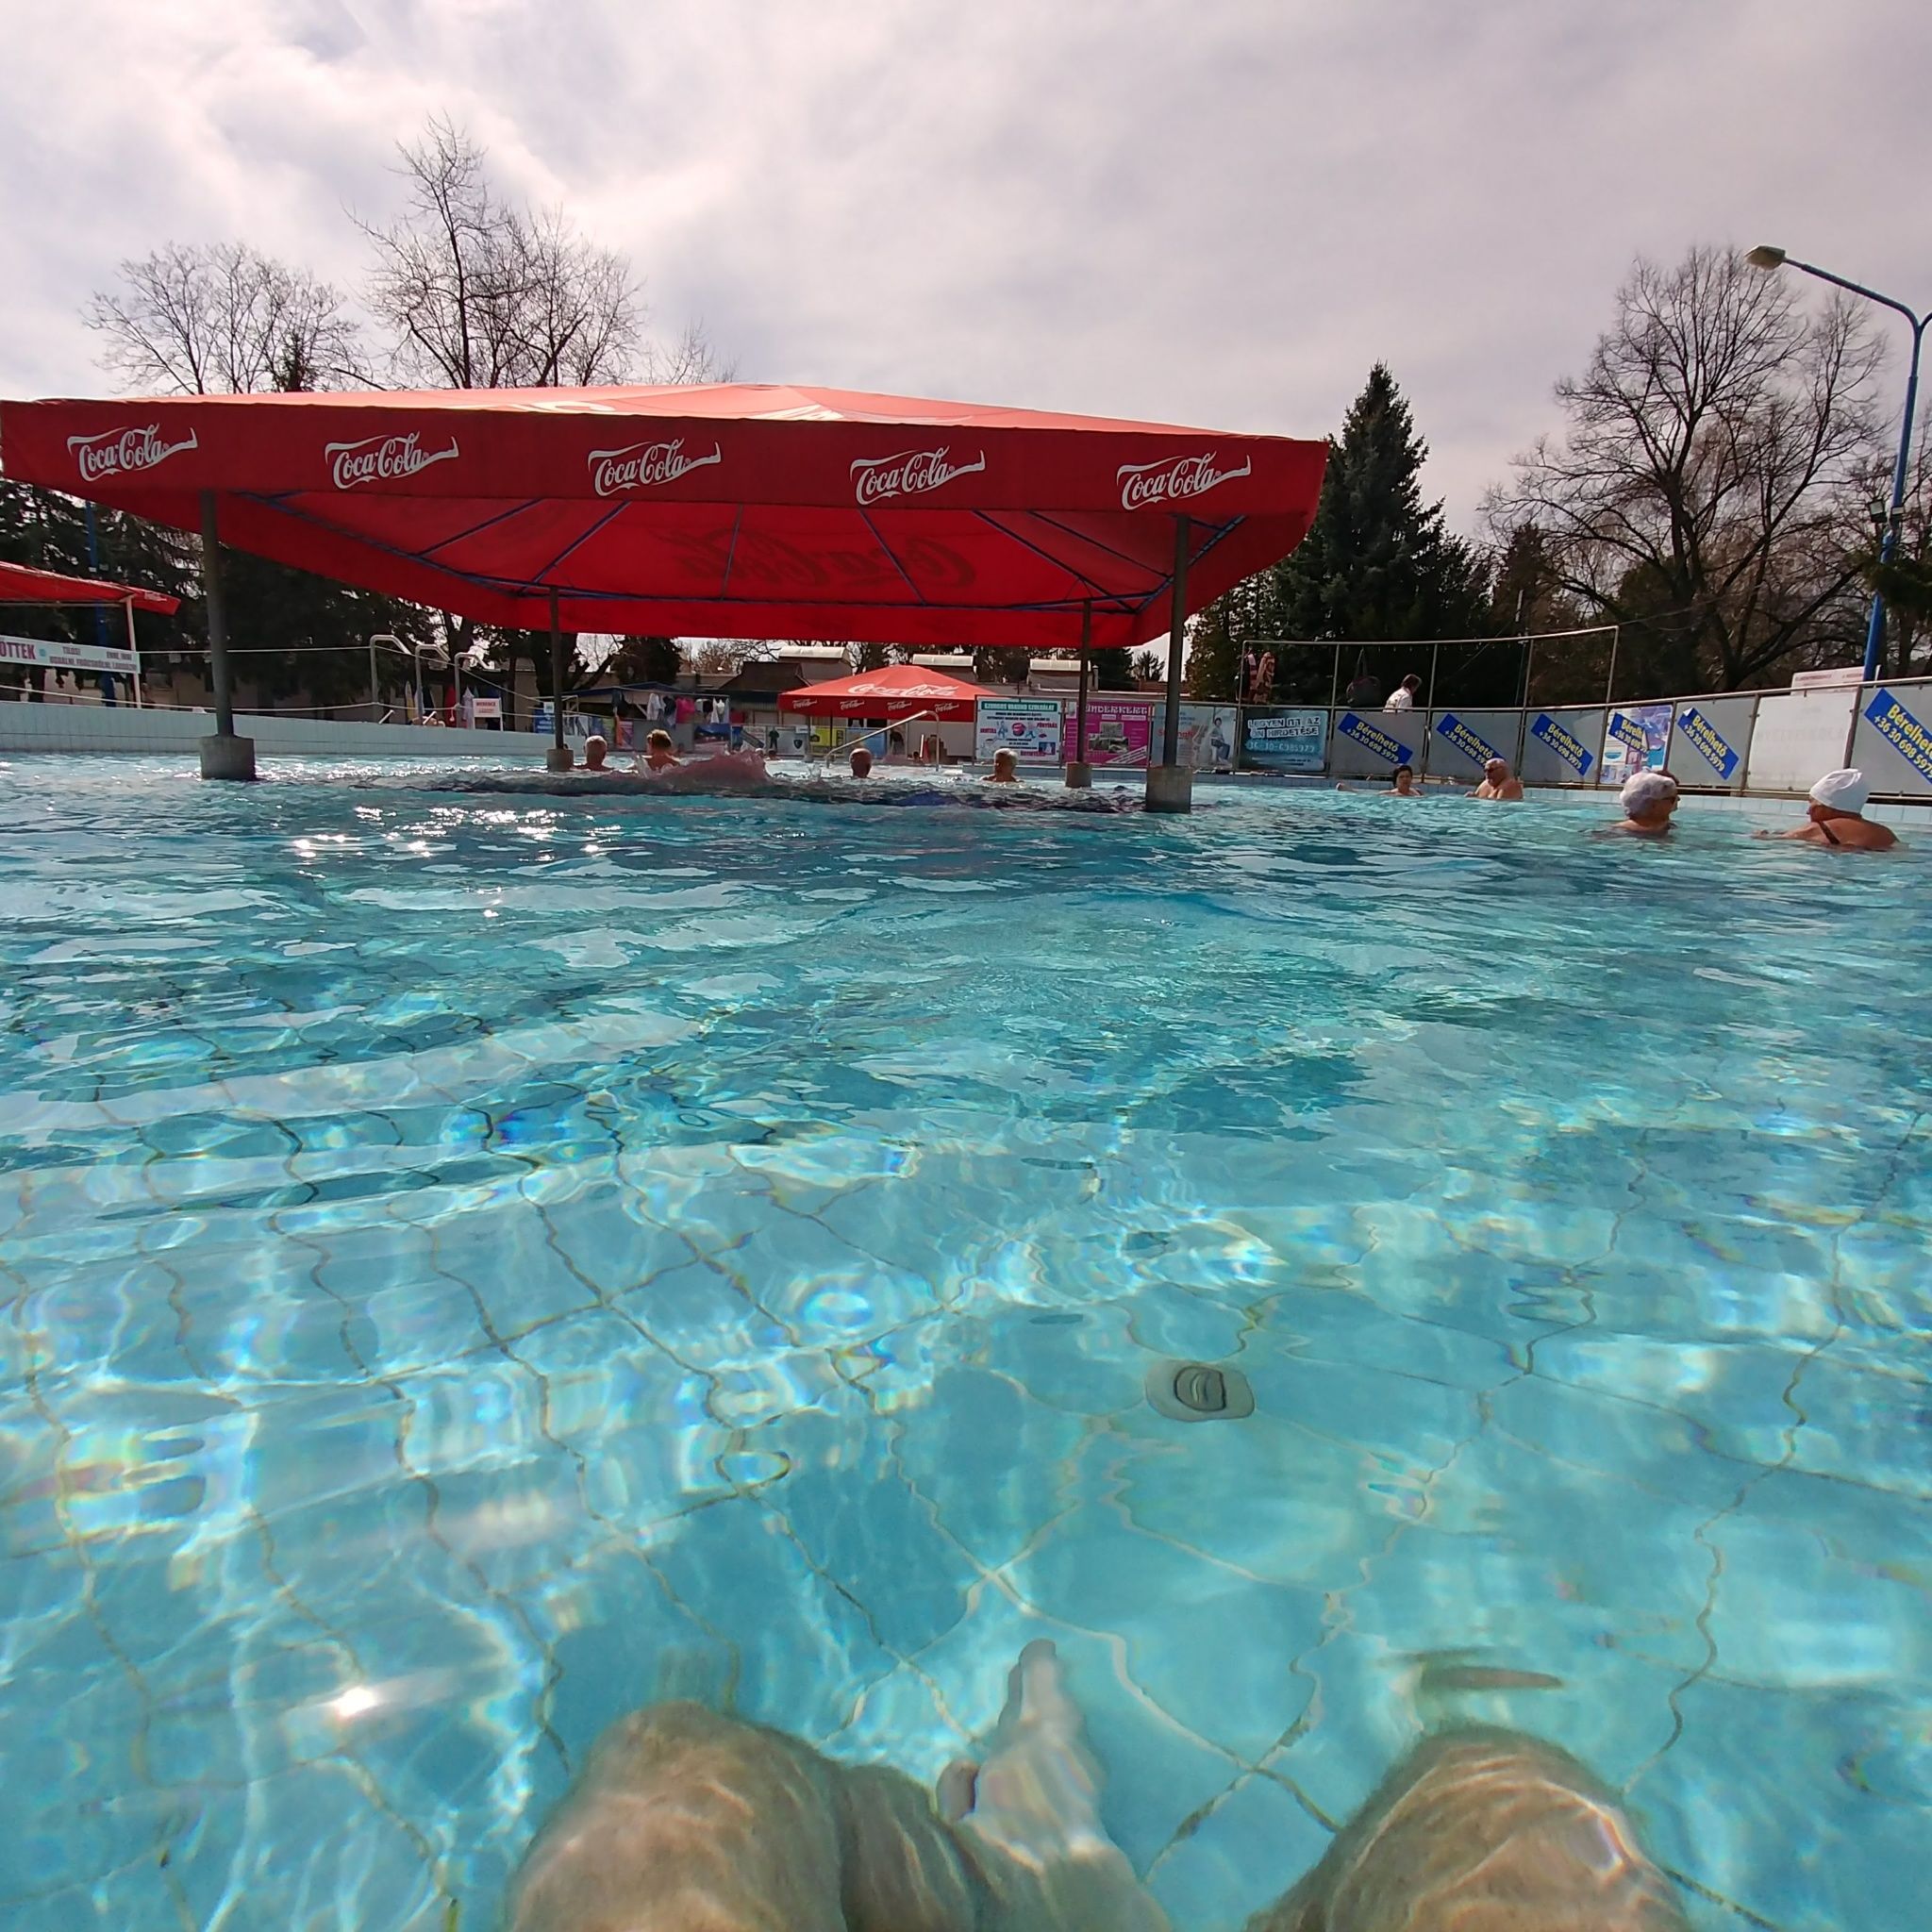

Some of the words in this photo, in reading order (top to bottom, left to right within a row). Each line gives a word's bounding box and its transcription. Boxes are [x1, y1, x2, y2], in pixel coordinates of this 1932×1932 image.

[77, 424, 165, 482] Coca-Cola
[332, 431, 426, 490] Coca-Cola
[594, 439, 689, 496] Coca-Cola
[857, 446, 951, 505] Coca-Cola
[1122, 453, 1217, 510] Coca-Cola
[1307, 717, 1321, 725] AZ
[1359, 736, 1369, 744] 30
[1693, 733, 1702, 745] 30
[1874, 715, 1891, 732] +36
[1888, 727, 1901, 742] 30
[1899, 740, 1917, 758] 698
[1913, 754, 1932, 778] 597
